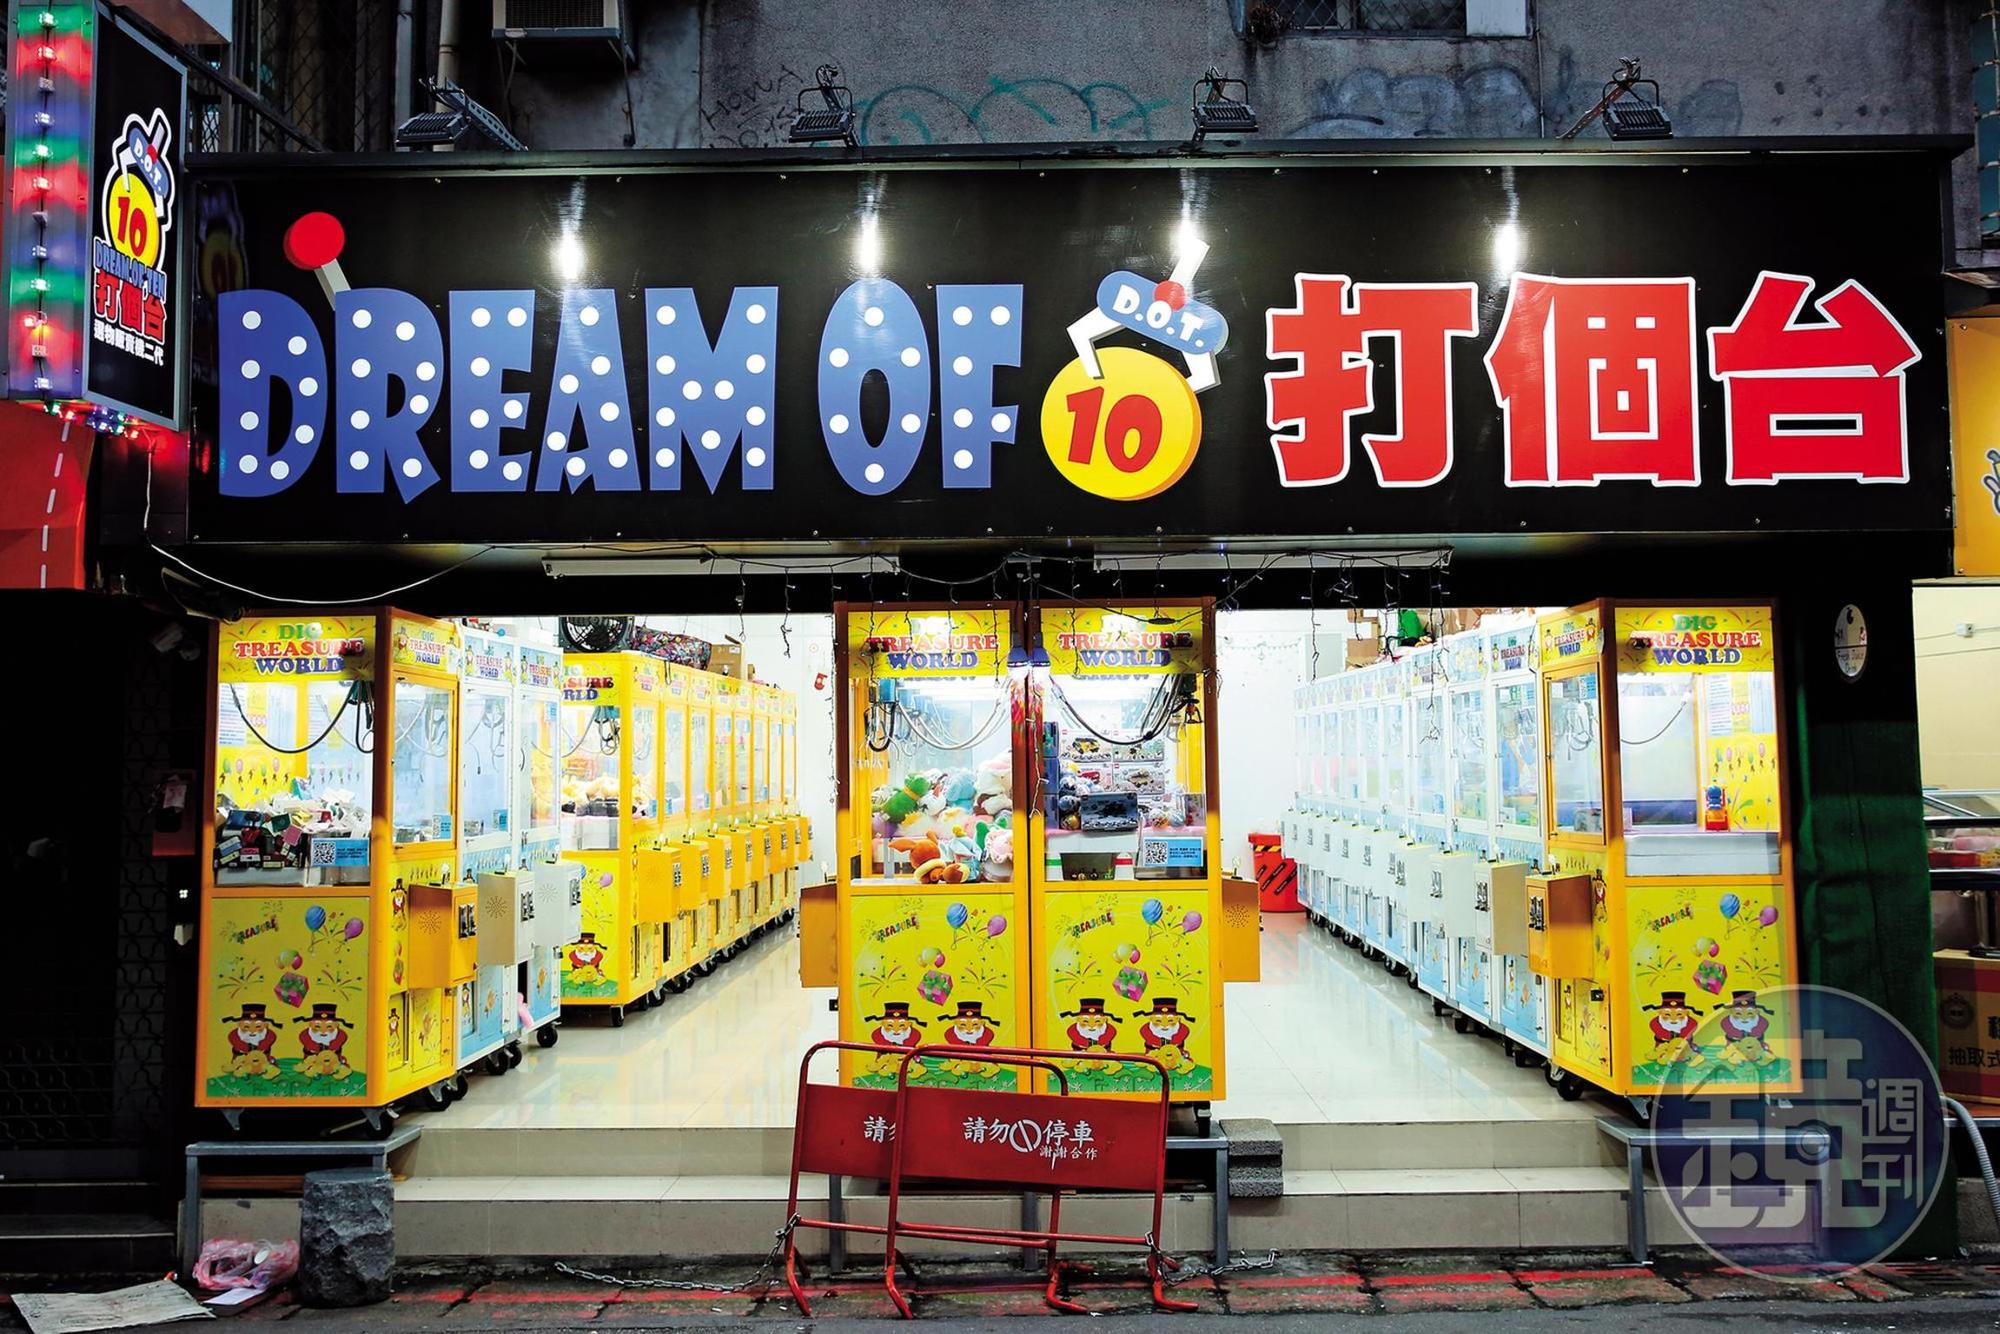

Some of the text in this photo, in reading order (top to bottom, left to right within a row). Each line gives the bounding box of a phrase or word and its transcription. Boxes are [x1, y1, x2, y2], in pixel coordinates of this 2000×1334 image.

[134, 136, 163, 193] D.O.T.
[117, 196, 147, 257] 10
[95, 241, 166, 301] DREAM OF TEN
[95, 268, 167, 345] 打個台
[1111, 283, 1205, 348] D.O.T.
[1264, 270, 1923, 489] 打個台
[218, 277, 1024, 505] DREAM OF
[1066, 385, 1163, 474] 10
[278, 622, 322, 641] DIG
[1673, 614, 1718, 631] DIG
[409, 638, 446, 656] TREASURE
[865, 634, 999, 653] TREASURE
[1058, 632, 1193, 650] TREASURE
[1554, 629, 1586, 646] TREASURE
[234, 638, 365, 659] TREASURE
[414, 651, 441, 665] WORLD
[1558, 642, 1581, 657] WORLD
[1652, 648, 1742, 666] WORLD
[255, 656, 346, 675] WORLD
[887, 651, 978, 670] WORLD
[1080, 649, 1172, 668] WORLD
[563, 676, 615, 689] SURE
[563, 688, 599, 701] RLD
[1948, 1046, 2000, 1068] 抽取式
[1039, 1145, 1099, 1161] 謝謝合作
